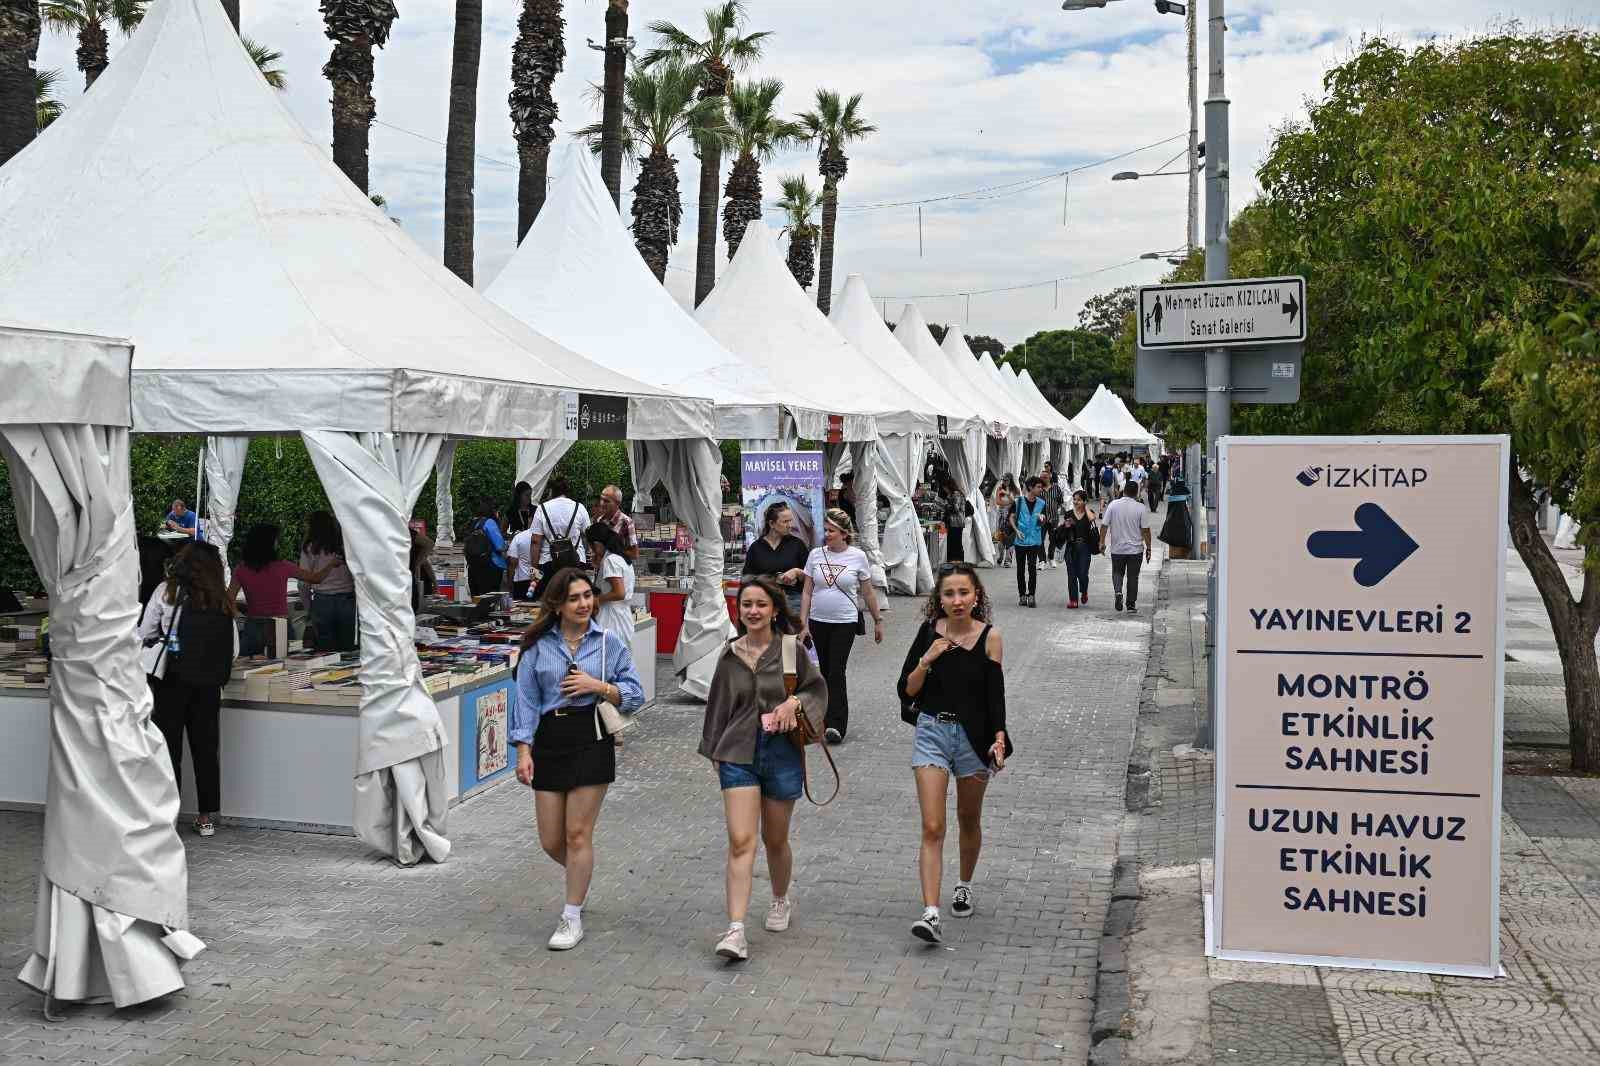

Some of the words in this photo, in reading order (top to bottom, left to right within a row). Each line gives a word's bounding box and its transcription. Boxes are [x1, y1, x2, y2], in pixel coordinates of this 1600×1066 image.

[1165, 295, 1202, 310] Mehmet
[1204, 292, 1234, 308] Tüzüm
[1237, 288, 1280, 306] KIZILCAN
[1191, 320, 1216, 336] Sanat
[1219, 318, 1254, 334] Galerisi
[745, 458, 786, 472] MAVİSEL
[788, 460, 818, 472] YENER
[1327, 464, 1427, 488] İZKİTAP
[1249, 604, 1443, 633] YAYINEVLERİ
[1454, 611, 1471, 634] 2
[1277, 670, 1429, 700] MONTRÖ
[1281, 706, 1434, 741] ETKİNLİK
[1285, 743, 1428, 775] SAHNESİ
[1249, 808, 1338, 835] UZUN
[1351, 812, 1466, 841] HAVUZ
[1280, 843, 1432, 879] ETKİNLİK
[1283, 886, 1426, 917] SAHNESİ
